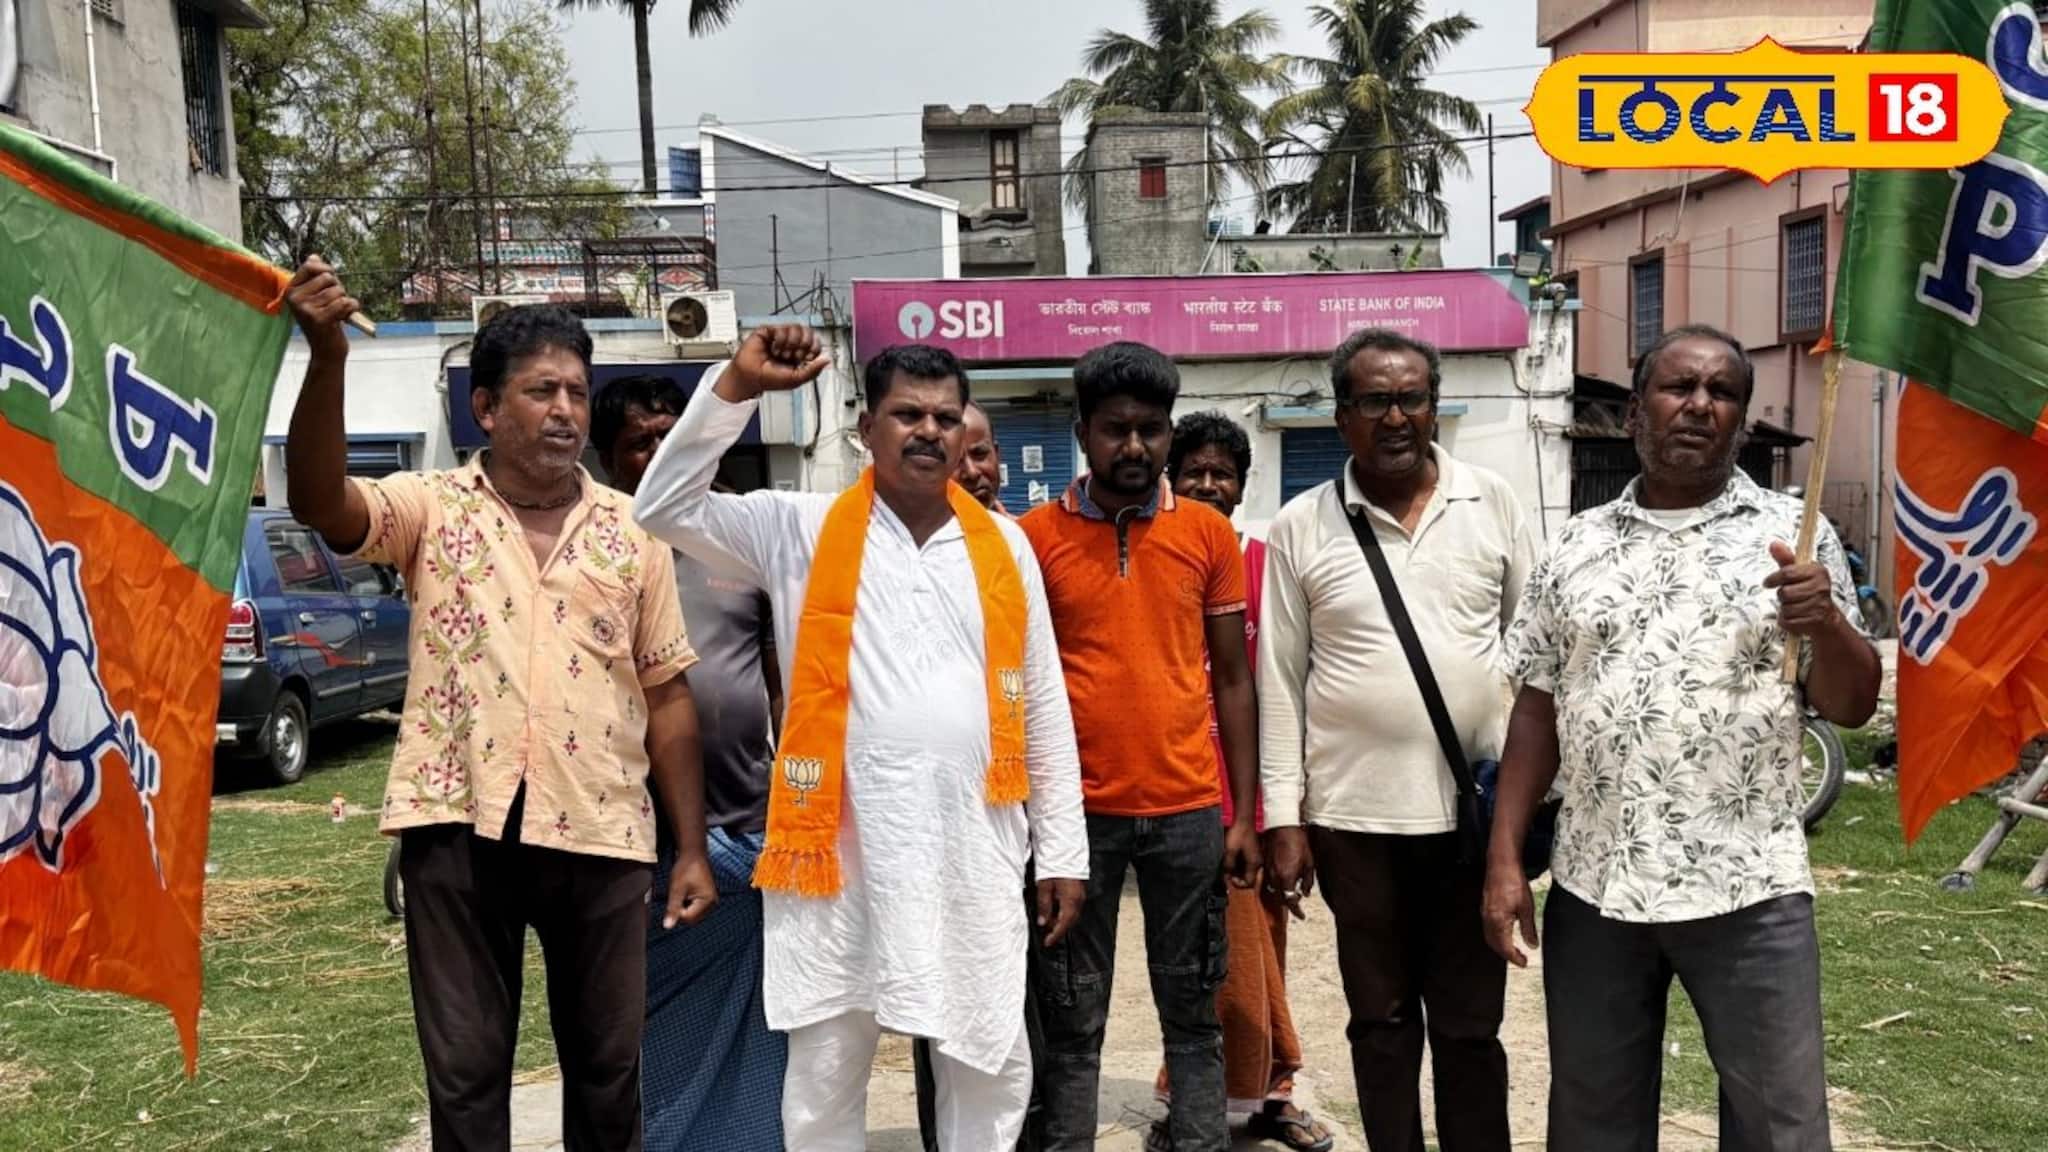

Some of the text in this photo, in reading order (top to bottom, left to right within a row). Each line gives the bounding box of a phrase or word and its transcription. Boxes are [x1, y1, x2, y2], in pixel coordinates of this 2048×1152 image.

[1038, 298, 1087, 316] ভারতীয়
[1183, 296, 1228, 314] भारतीय
[1232, 297, 1257, 314] स्टेट
[1319, 296, 1445, 312] STATE BANK OF INDIA
[940, 299, 1004, 339] SBI
